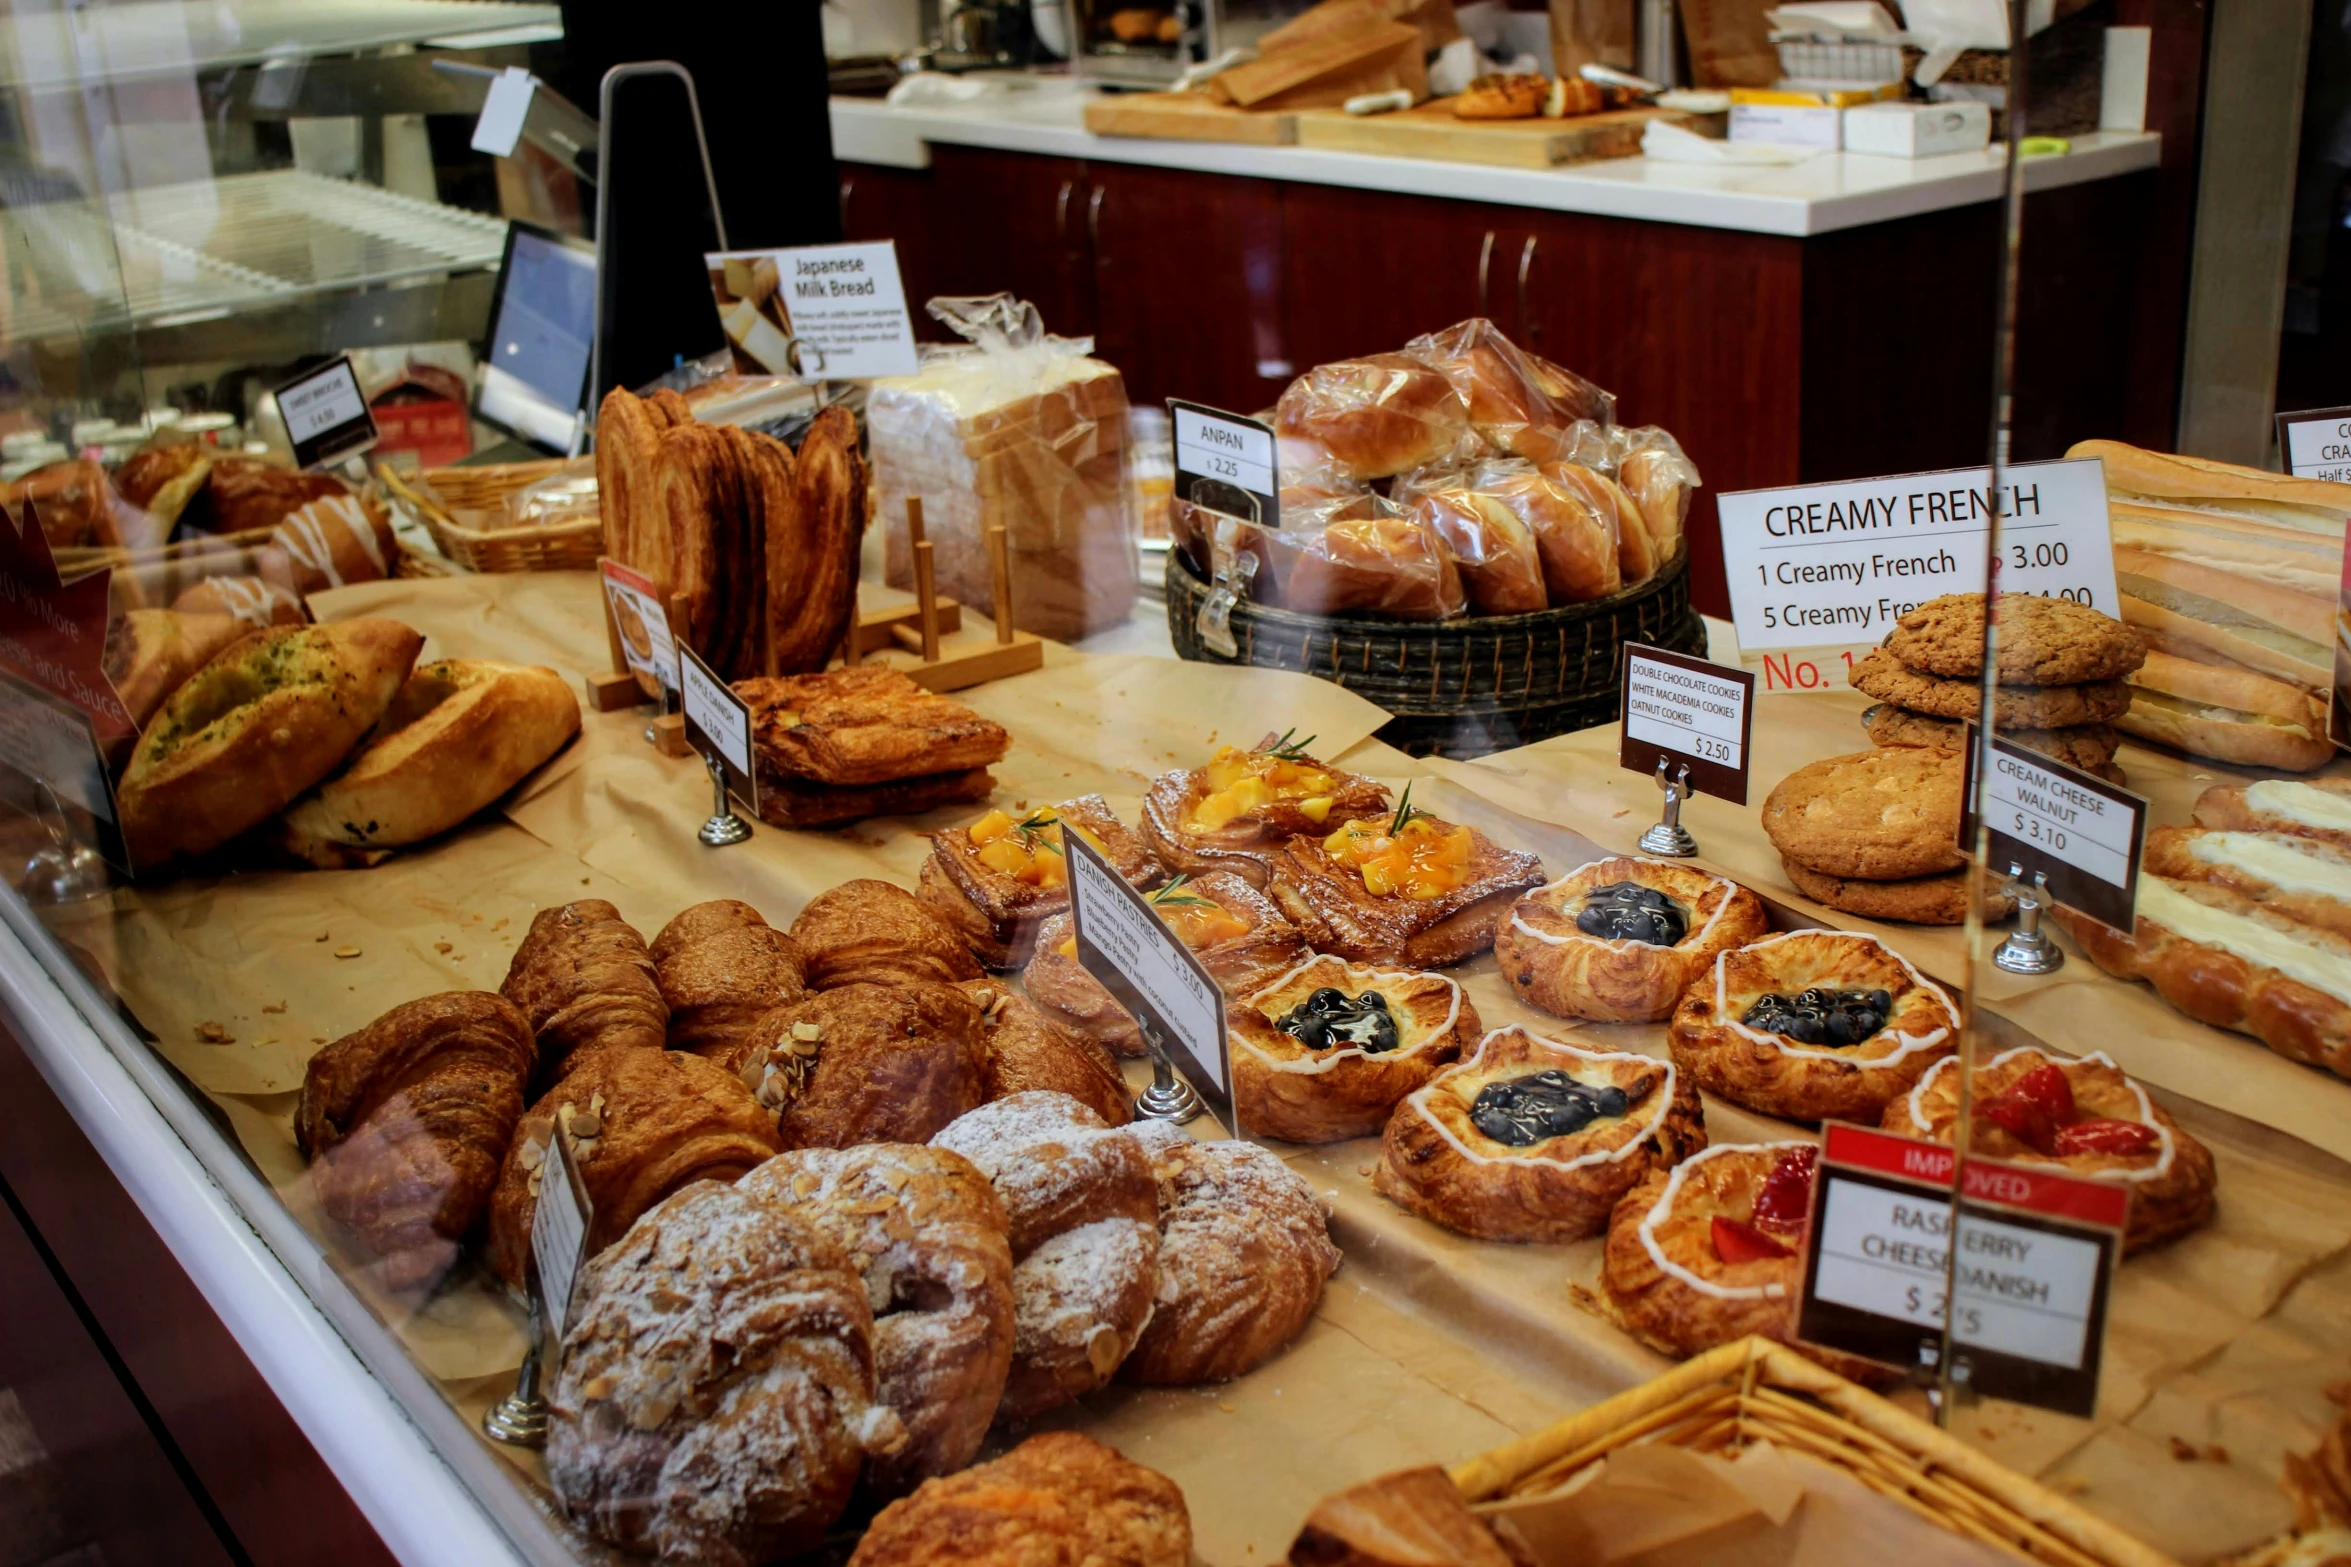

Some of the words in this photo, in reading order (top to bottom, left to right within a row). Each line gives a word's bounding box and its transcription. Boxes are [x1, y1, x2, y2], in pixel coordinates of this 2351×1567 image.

[796, 258, 865, 276] Japanese
[796, 280, 828, 297] Milk
[830, 276, 875, 297] Bread
[1201, 426, 1243, 450] ANPAN
[1215, 458, 1239, 477] 2.25
[2318, 468, 2343, 482] Half
[1765, 496, 1897, 538] CREAMY
[1758, 564, 1767, 586] 1
[1776, 561, 1865, 586] Creamy
[1872, 548, 1956, 578] French
[2012, 541, 2069, 569] 3.00
[40, 597, 79, 643] More
[1764, 607, 1776, 628] 5
[1783, 604, 1872, 629] Creamy
[36, 655, 66, 691] and
[69, 670, 123, 725] Sauce
[1632, 663, 1662, 681] DOUBLE
[1662, 671, 1707, 693] CHOCOLATE
[1707, 683, 1741, 701] COOKIES
[1763, 652, 1830, 690] No.
[690, 671, 709, 698] APPLE
[709, 689, 735, 726] DANISH
[1631, 699, 1661, 715] OATNUT
[1661, 707, 1693, 725] COOKIES
[1632, 681, 1655, 697] WHITE
[1655, 687, 1701, 710] MACADEMIA
[1702, 700, 1735, 719] COOKIES
[702, 711, 709, 729] $
[708, 718, 724, 744] 3.00
[1695, 736, 1702, 755] $
[1705, 740, 1730, 761] 2.50
[1997, 758, 2047, 790] CREAM
[2050, 781, 2106, 817] CHEESE
[2017, 786, 2079, 825] WALNUT
[2014, 811, 2024, 833] $
[2029, 820, 2067, 850] 3.10
[1077, 854, 1117, 902] DANISH
[1116, 892, 1161, 949] PASTRIES
[1172, 951, 1180, 973] $
[1182, 962, 1204, 1000] 3.00
[1083, 888, 1120, 931] Strawberry
[1120, 923, 1141, 953] Pastry
[1086, 904, 1118, 944] Blueberry
[1118, 936, 1139, 966] Pastry
[1088, 921, 1112, 951] Mango
[1112, 944, 1133, 975] Pastry
[1132, 969, 1148, 991] with
[1148, 985, 1174, 1021] coconut
[1174, 1015, 1198, 1049] custard
[1904, 1149, 2031, 1201] IMPOVED
[1905, 1286, 1920, 1313] $
